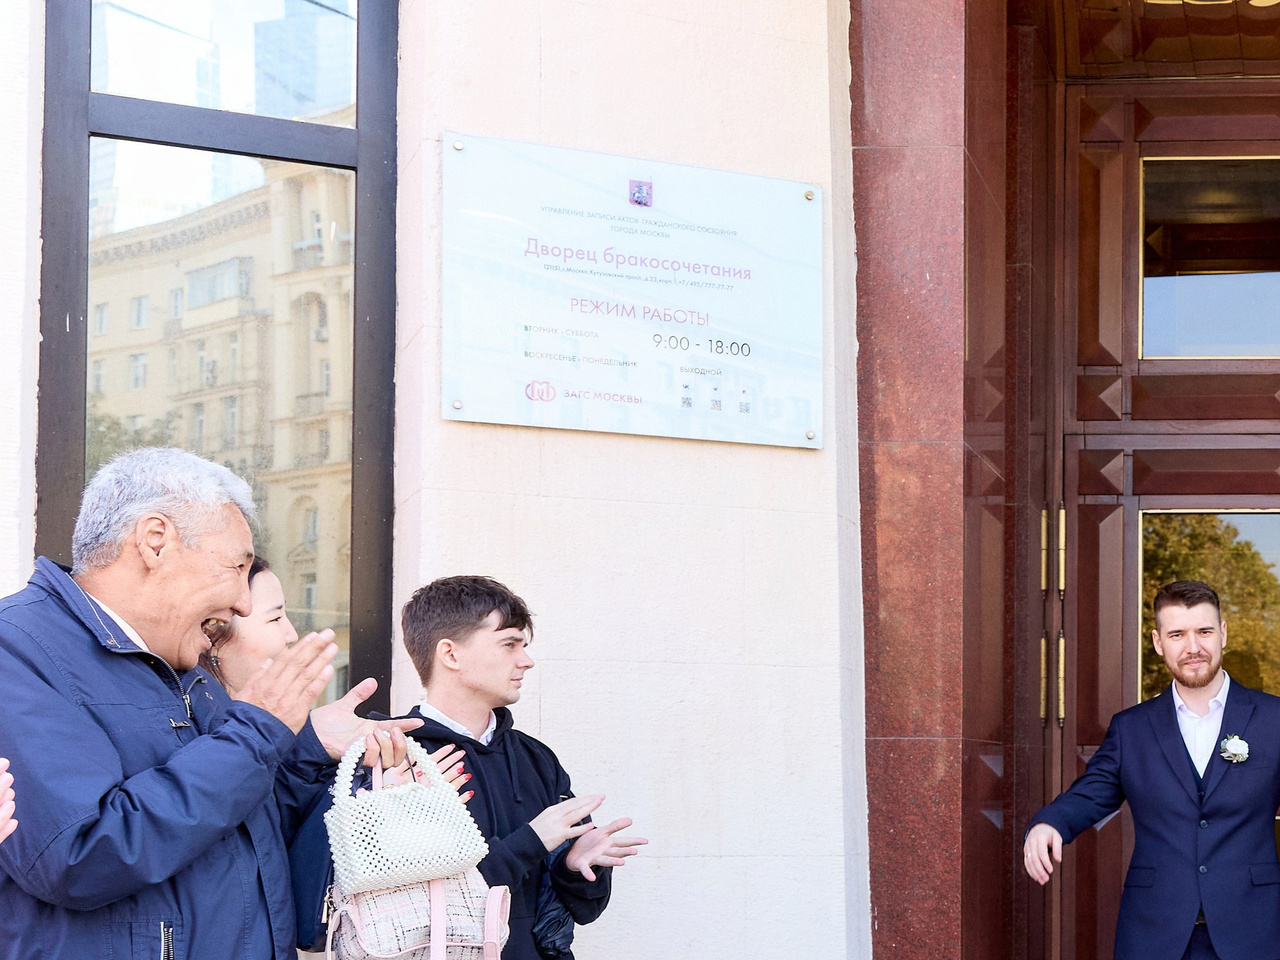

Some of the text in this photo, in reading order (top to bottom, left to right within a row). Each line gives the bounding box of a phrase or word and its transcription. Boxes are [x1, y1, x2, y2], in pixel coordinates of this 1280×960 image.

[541, 206, 738, 236] УПРАВЛЕНИЕ ЗАПИСИ АКТОВ ГРАЖДАНСКОГО СОСТОЯНИЯ
[611, 225, 671, 238] ГОРОДА МОСКВЫ
[524, 237, 752, 280] Дворец бракосочетания
[570, 298, 709, 326] РЕЖИМ РАБОТЫ
[524, 324, 559, 335] ВТОРНИК
[565, 328, 600, 339] СУББОТА
[652, 333, 690, 351] 9:00
[708, 339, 751, 357] 18:00
[524, 351, 577, 362] ВОСКРЕСЕНЬЕ
[582, 356, 639, 367] ПОНЕДЕЛЬНИК
[680, 366, 722, 376] ВЫХОДНОЙ
[564, 389, 643, 404] ЗАГС МОСКВЫ
